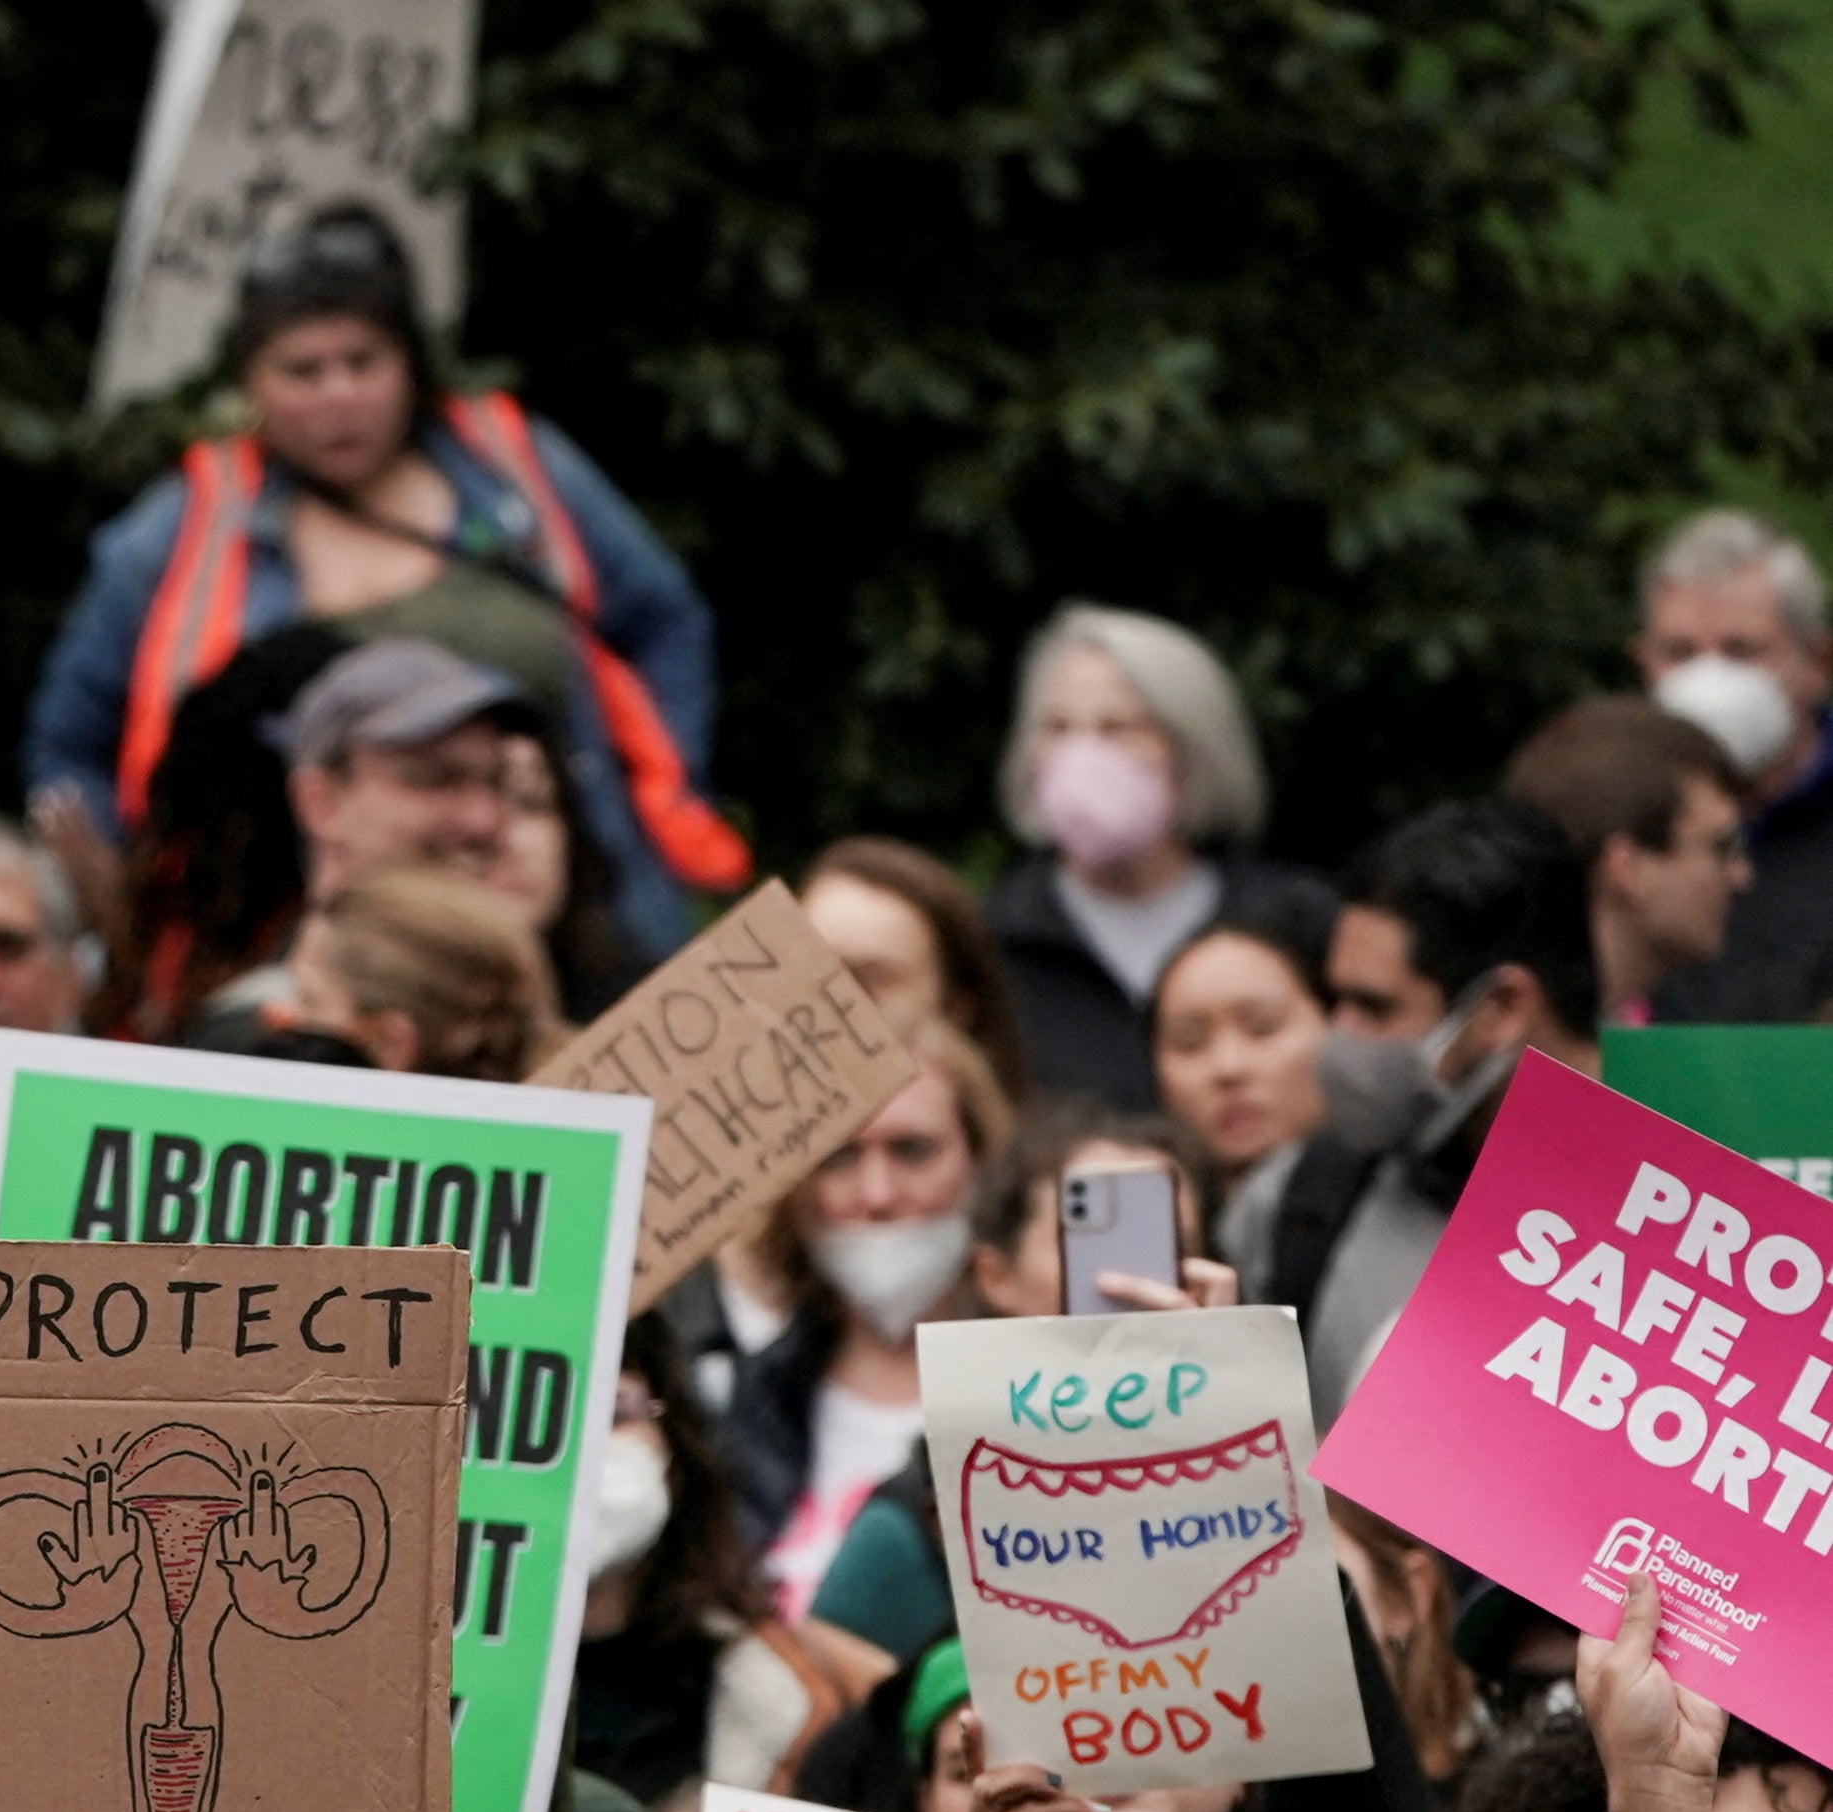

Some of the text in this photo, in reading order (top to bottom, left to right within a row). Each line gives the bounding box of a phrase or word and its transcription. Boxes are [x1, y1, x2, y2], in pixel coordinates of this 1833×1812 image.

[71, 1124, 545, 1288] ABORTION
[1615, 1160, 1833, 1343] PRO
[1498, 1208, 1756, 1408] SAFE,
[982, 1523, 1103, 1567] YOUR
[1655, 1534, 1739, 1592] Planned
[1677, 1626, 1710, 1652] Action
[1709, 1643, 1737, 1667] Fund
[1062, 1682, 1264, 1765] BODY
